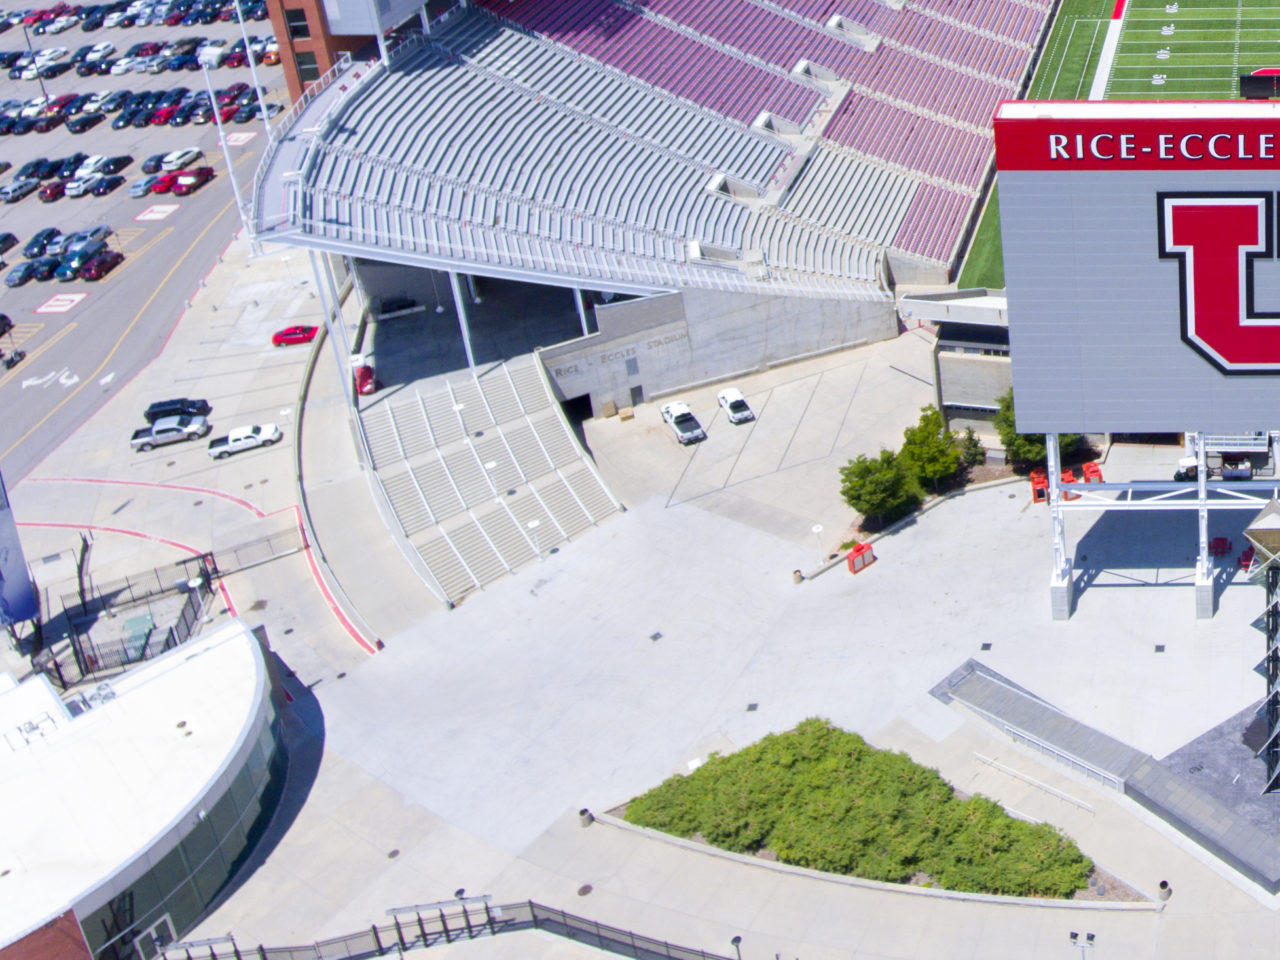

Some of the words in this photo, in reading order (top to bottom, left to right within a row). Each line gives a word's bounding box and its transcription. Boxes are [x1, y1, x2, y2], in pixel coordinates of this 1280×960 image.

[1165, 4, 1179, 13] 20
[1161, 26, 1175, 35] 30
[1156, 49, 1170, 59] 40
[1151, 74, 1167, 85] 50
[555, 364, 579, 378] RICE
[600, 347, 637, 363] ECCLES
[647, 329, 689, 351] STADIUM
